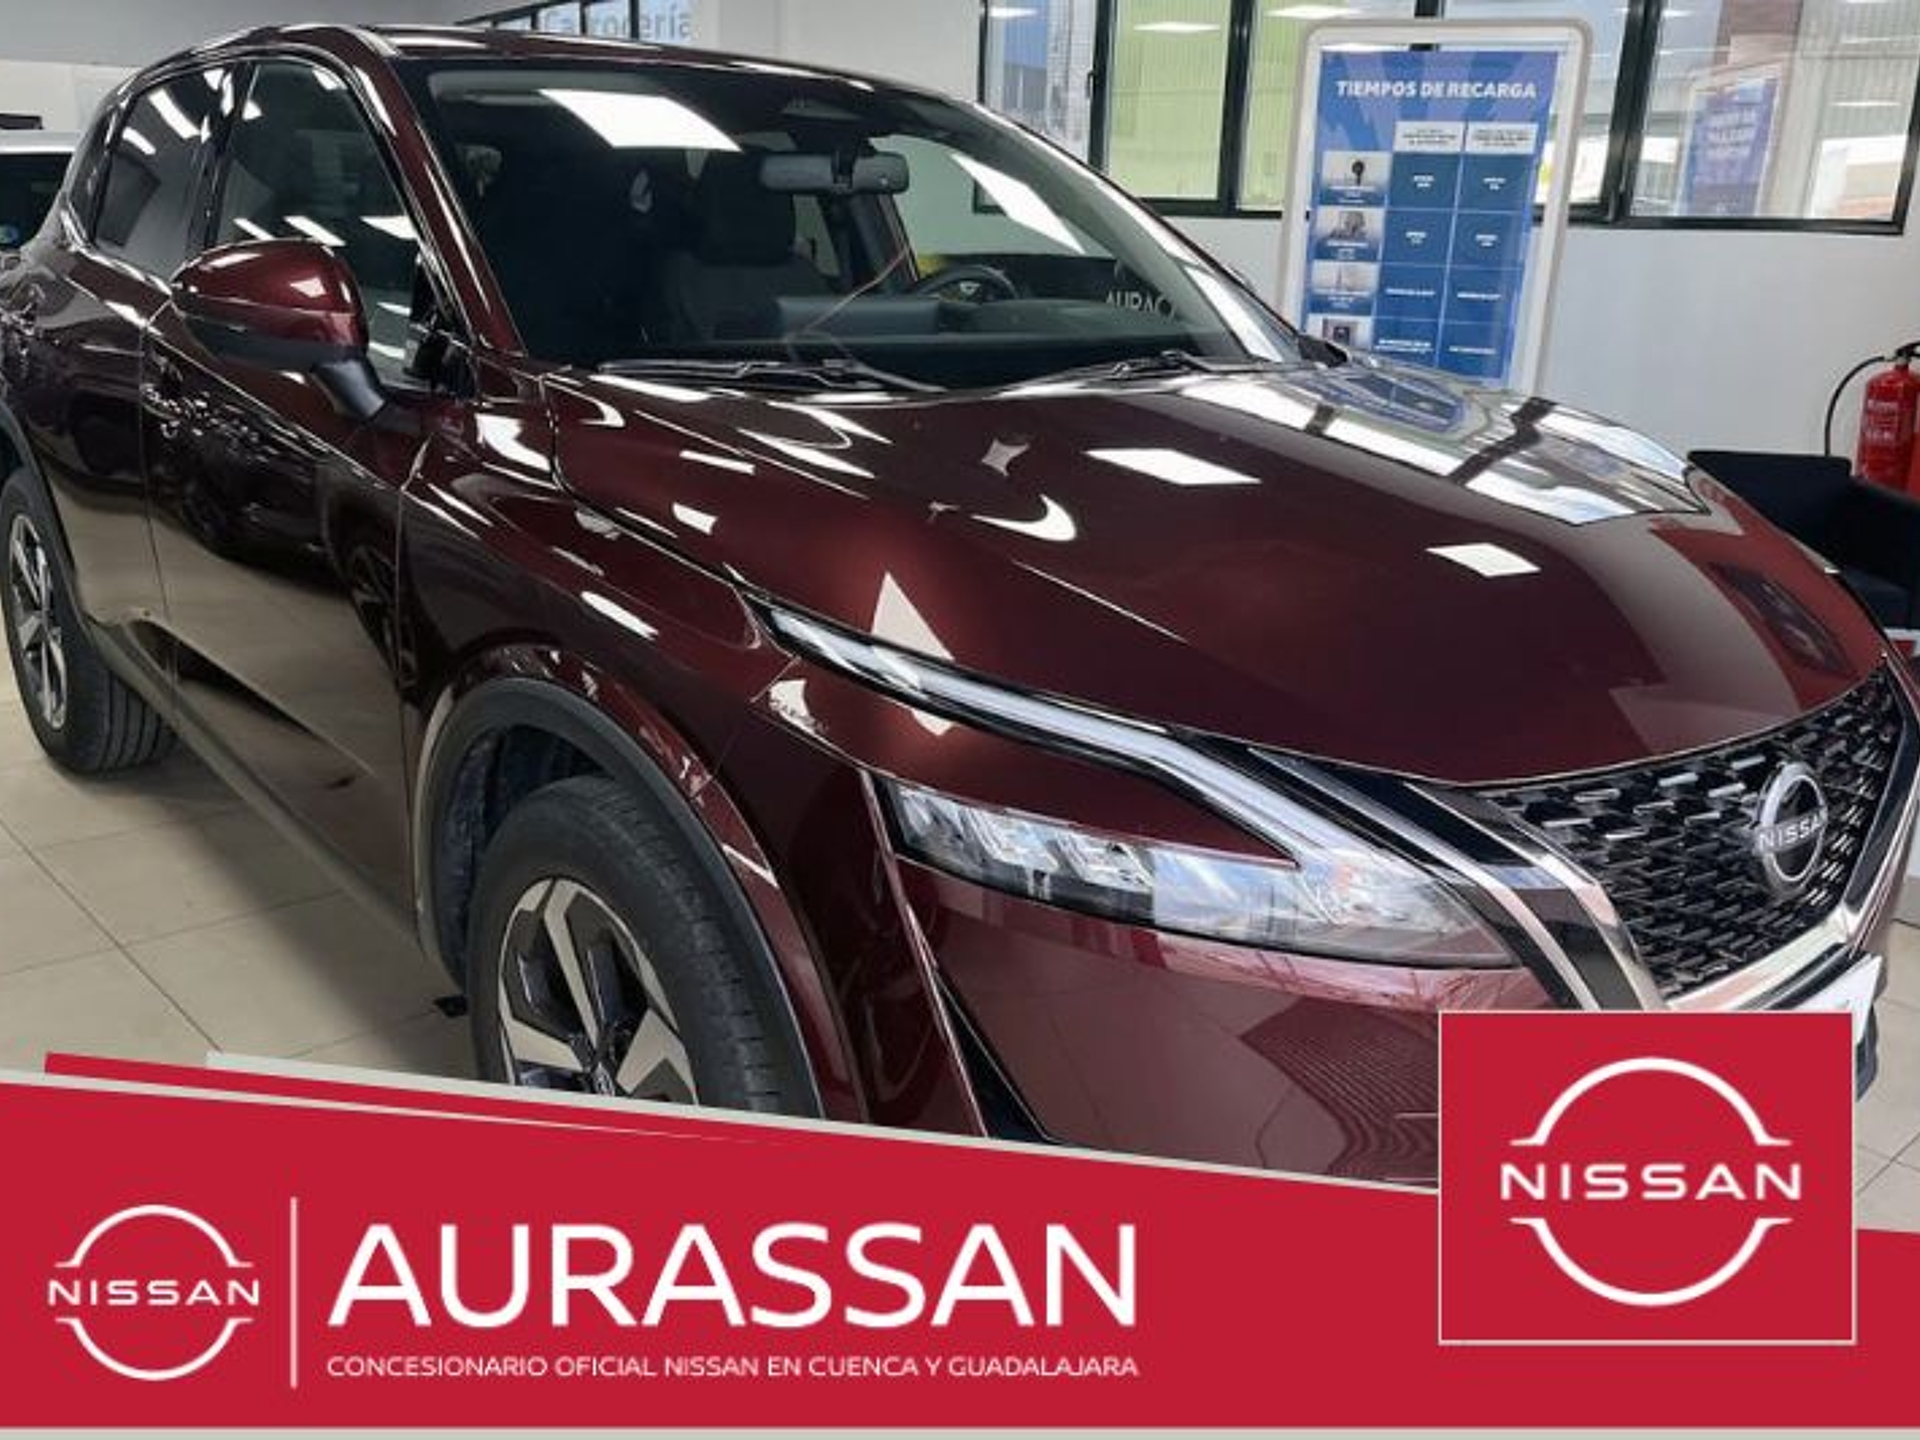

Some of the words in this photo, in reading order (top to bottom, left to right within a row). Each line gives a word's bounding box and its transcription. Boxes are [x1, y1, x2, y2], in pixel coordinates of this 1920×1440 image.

[1336, 80, 1417, 98] TIEMPOS
[1419, 81, 1445, 98] DE
[1448, 82, 1537, 99] RECARGA
